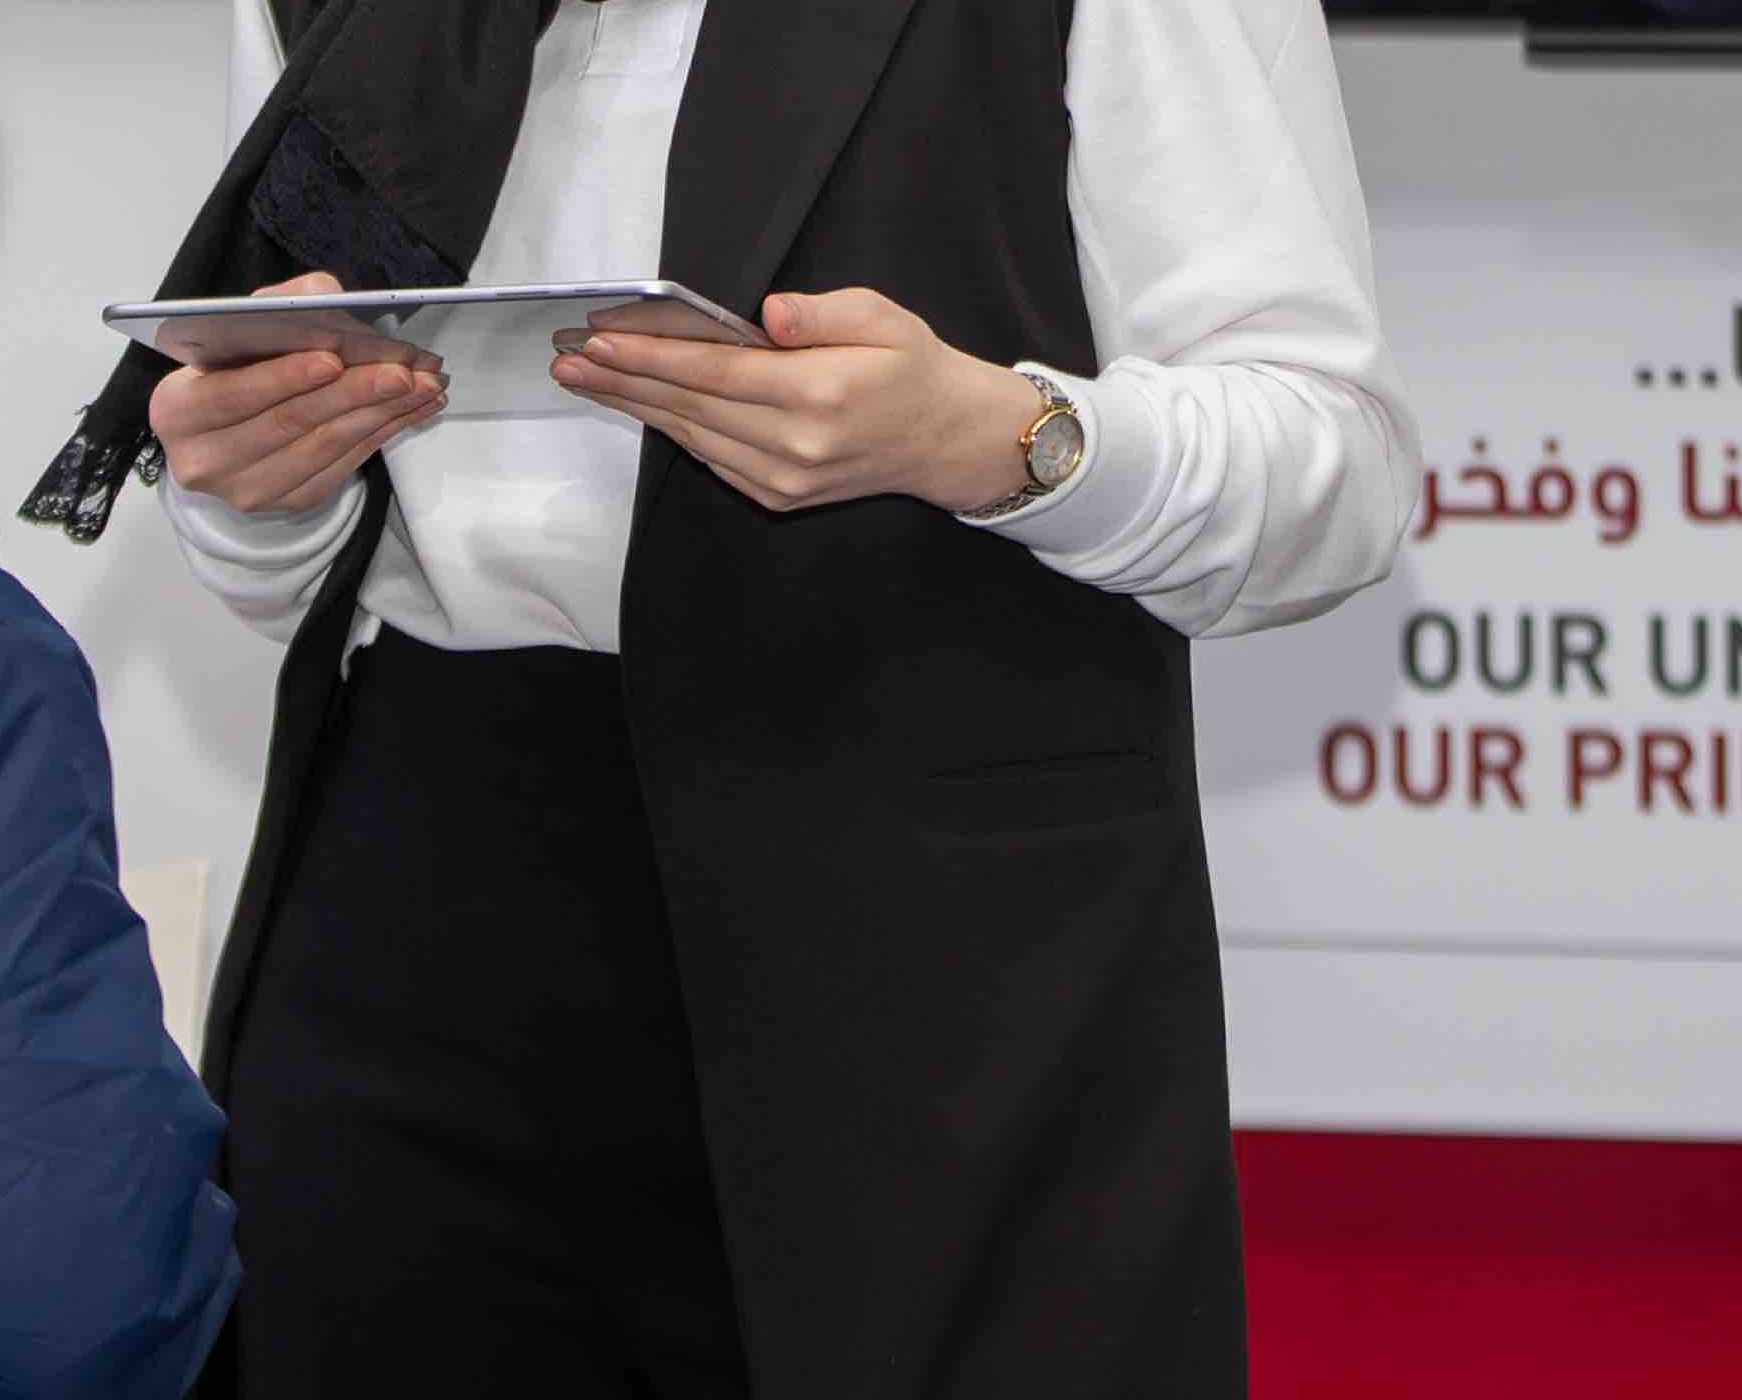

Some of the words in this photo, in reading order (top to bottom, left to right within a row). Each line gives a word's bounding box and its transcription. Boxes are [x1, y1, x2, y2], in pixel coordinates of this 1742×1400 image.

[1411, 436, 1641, 545] وفخر
[1399, 609, 1609, 696] OUR
[1316, 719, 1526, 810] OUR
